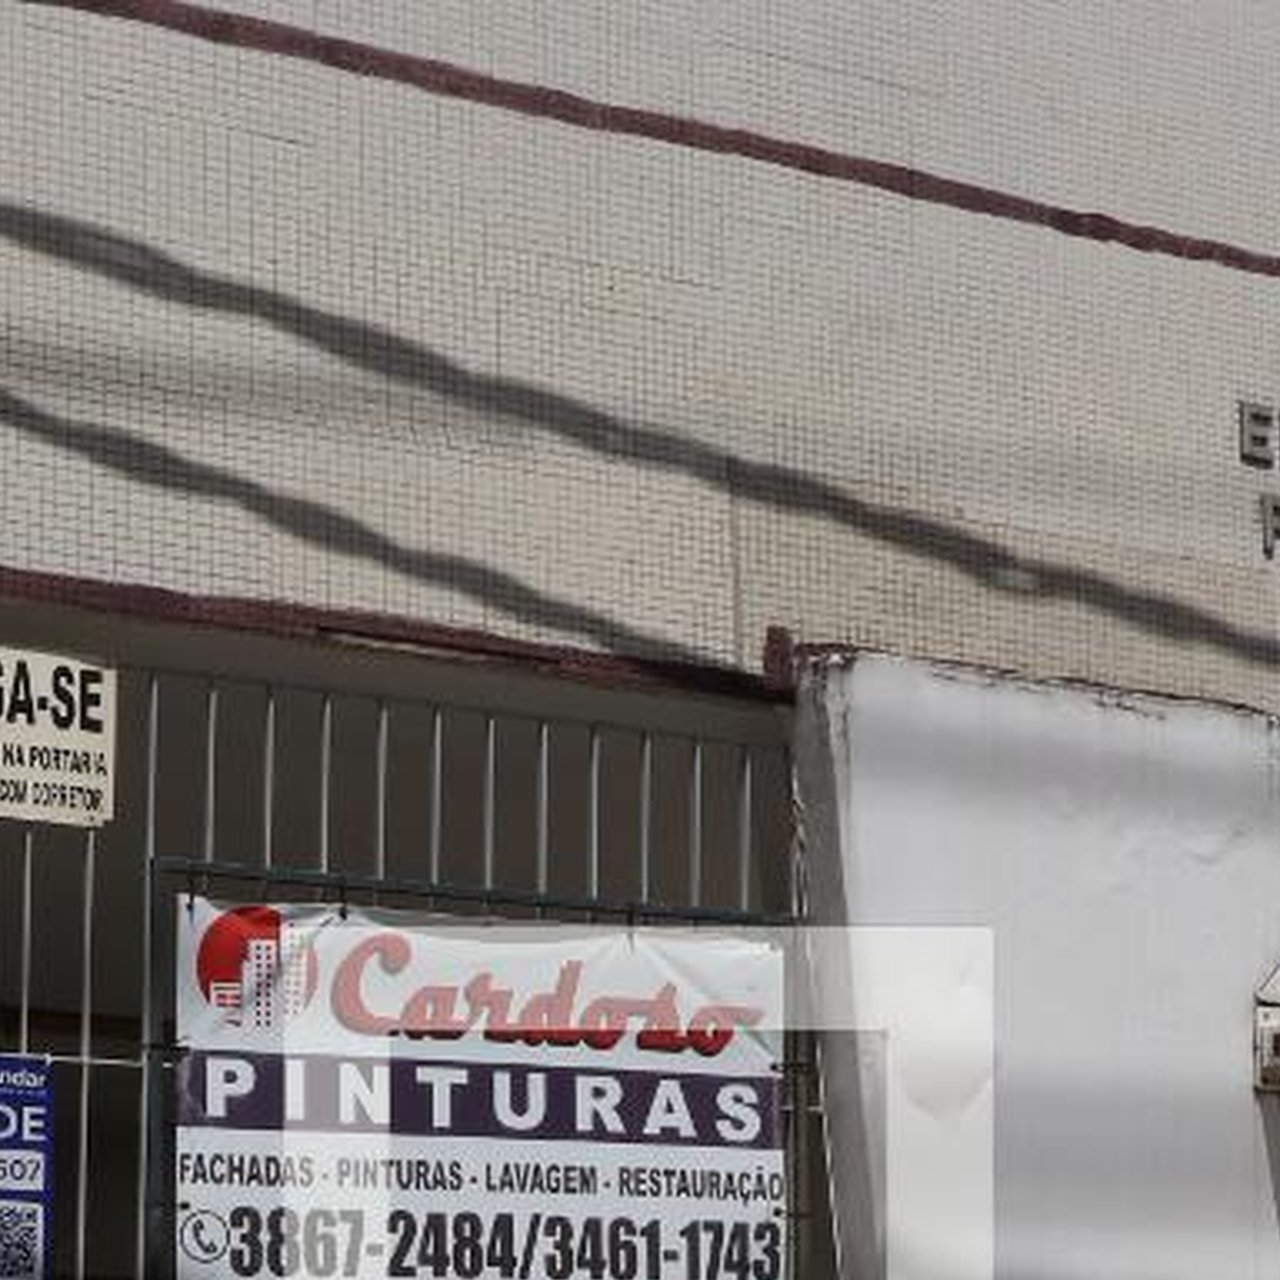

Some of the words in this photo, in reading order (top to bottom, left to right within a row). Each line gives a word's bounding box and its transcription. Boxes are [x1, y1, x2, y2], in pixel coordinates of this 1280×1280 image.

[30, 746, 107, 776] PORTARIA
[329, 932, 765, 1057] Cardoso
[204, 1057, 762, 1142] PINTURAS
[179, 1153, 315, 1188] FACHADAS
[337, 1159, 463, 1191] PINTURAS
[485, 1163, 599, 1195] LAVAGEM
[619, 1166, 784, 1206] RESTAURAÇÃO
